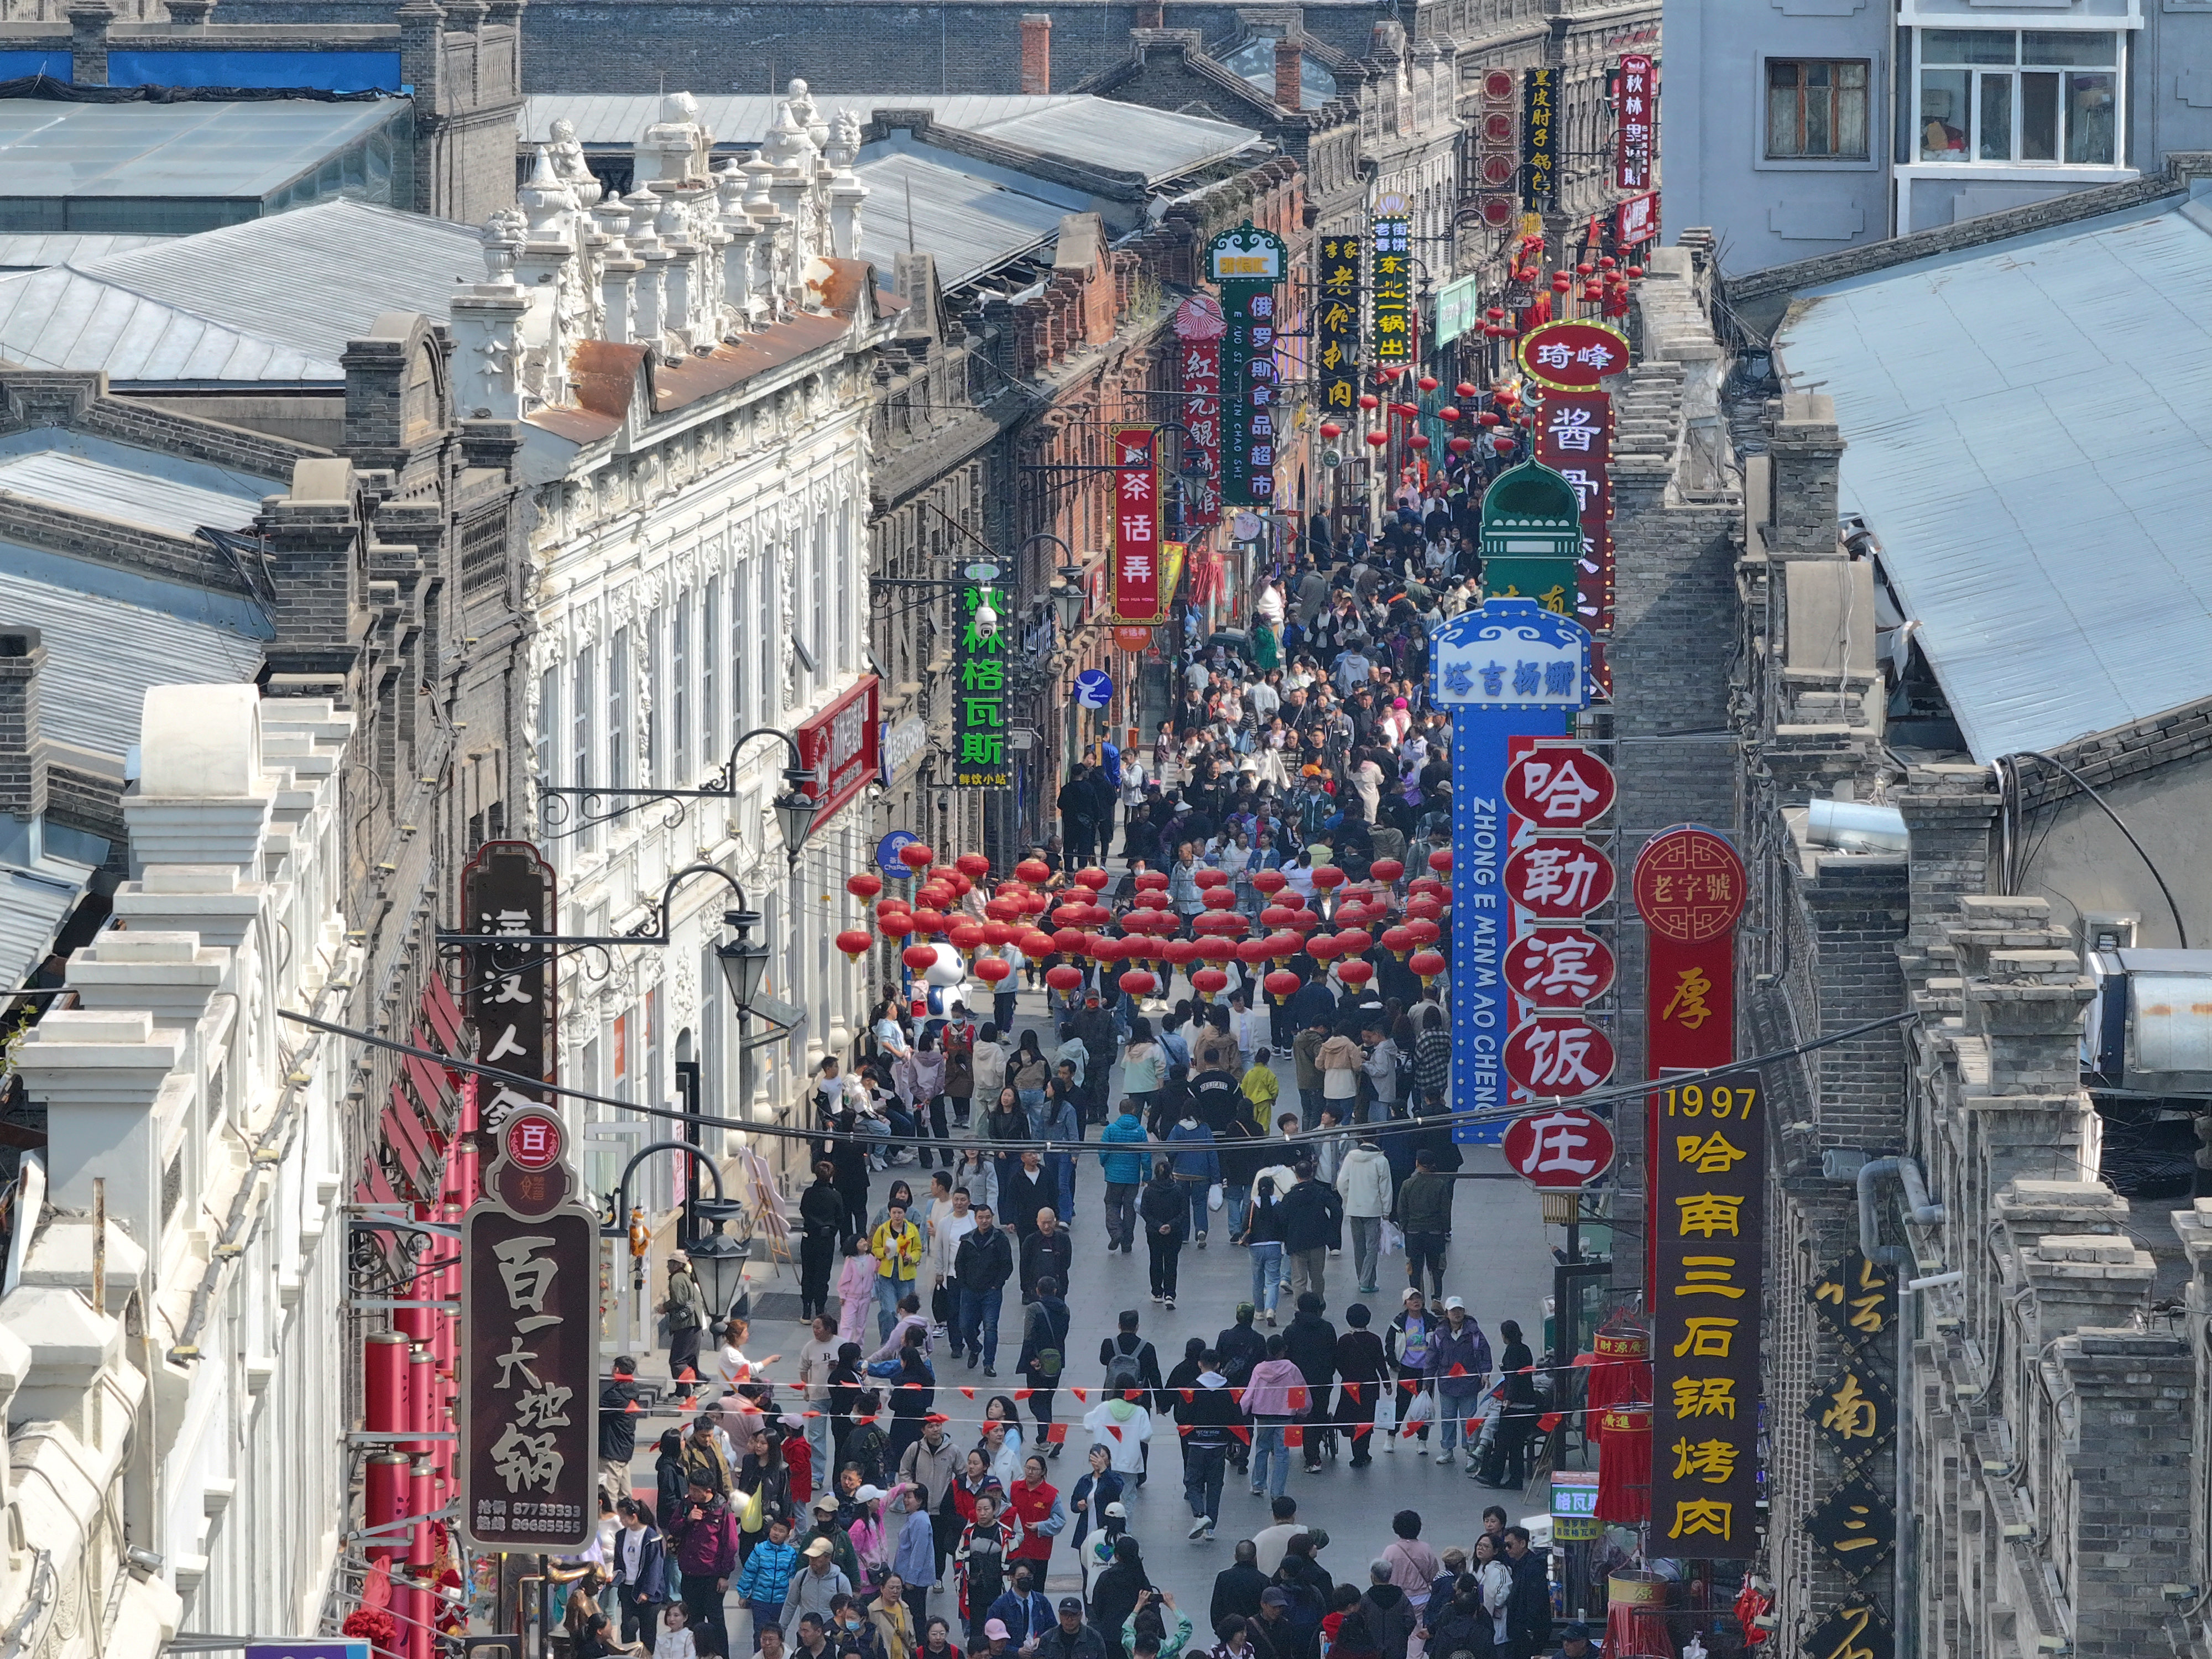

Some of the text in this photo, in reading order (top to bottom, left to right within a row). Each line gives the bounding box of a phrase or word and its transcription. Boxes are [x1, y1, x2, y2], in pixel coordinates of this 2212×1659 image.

[1531, 70, 1552, 208] 黑皮肘子锅包
[1375, 222, 1407, 237] 老街
[1324, 241, 1358, 259] 李家
[1375, 238, 1407, 252] 春饼
[1377, 255, 1405, 356] 东北一锅出
[1233, 351, 1242, 363] SI
[1536, 342, 1615, 371] 琦峰
[1251, 296, 1273, 495] 俄罗斯食品超市
[1233, 423, 1243, 452] CHAO
[1233, 459, 1242, 479] SHI
[1121, 473, 1152, 583] 茶话弄
[969, 566, 994, 578] 正宗
[961, 586, 1005, 765] 秋林格瓦斯
[959, 773, 1006, 785] 鲜饮小站
[1473, 797, 1497, 886] ZHONG
[1473, 894, 1496, 909] E
[1650, 873, 1733, 902] 老字號
[1522, 759, 1600, 1175] 哈勒滨饭庄
[1662, 967, 1713, 1030] 厚
[1664, 1083, 1756, 1120] 1997
[521, 1124, 548, 1161] 百一
[1667, 1130, 1746, 1541] 哈南三石锅烤肉
[490, 1237, 573, 1495] 百一大地锅
[513, 1502, 581, 1518] 87733333
[512, 1518, 581, 1533] 86685555
